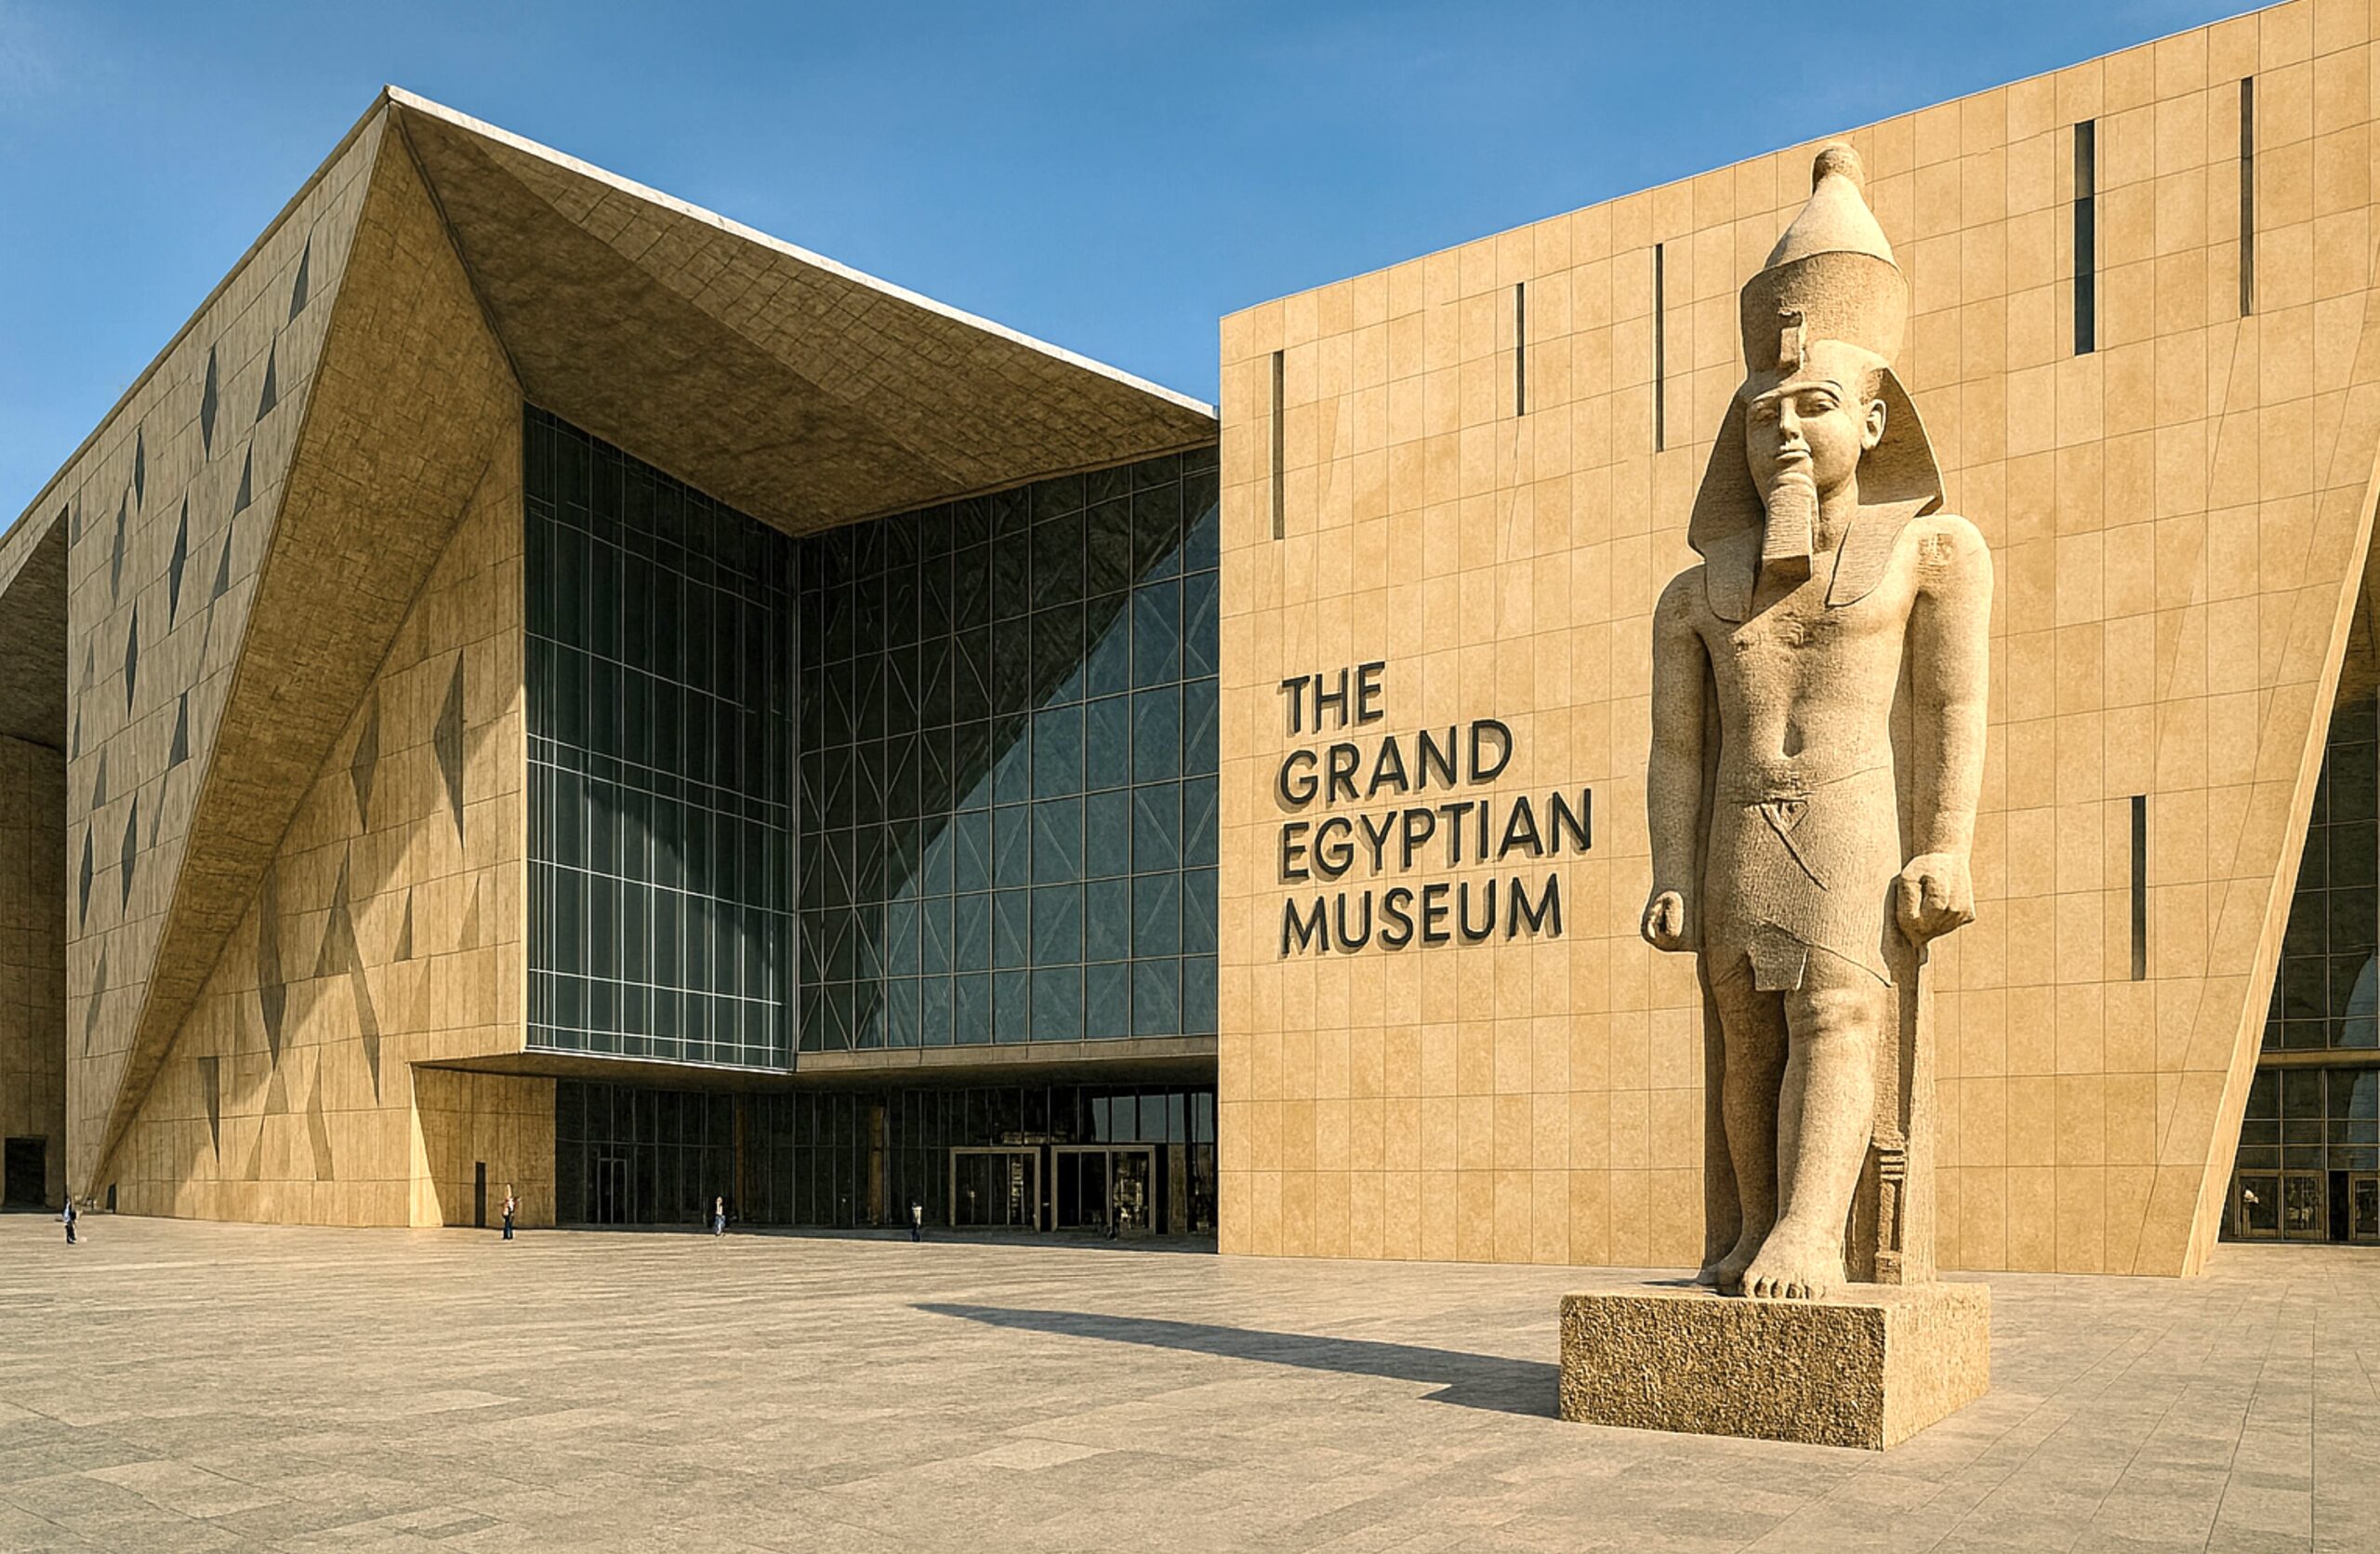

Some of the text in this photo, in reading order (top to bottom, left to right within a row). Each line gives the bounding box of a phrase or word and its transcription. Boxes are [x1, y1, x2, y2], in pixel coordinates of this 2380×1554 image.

[1281, 661, 1385, 733] THE
[1280, 719, 1513, 805] GRAND
[1283, 789, 1592, 880] EGYPTIAN
[1281, 872, 1563, 956] MUSEUM
